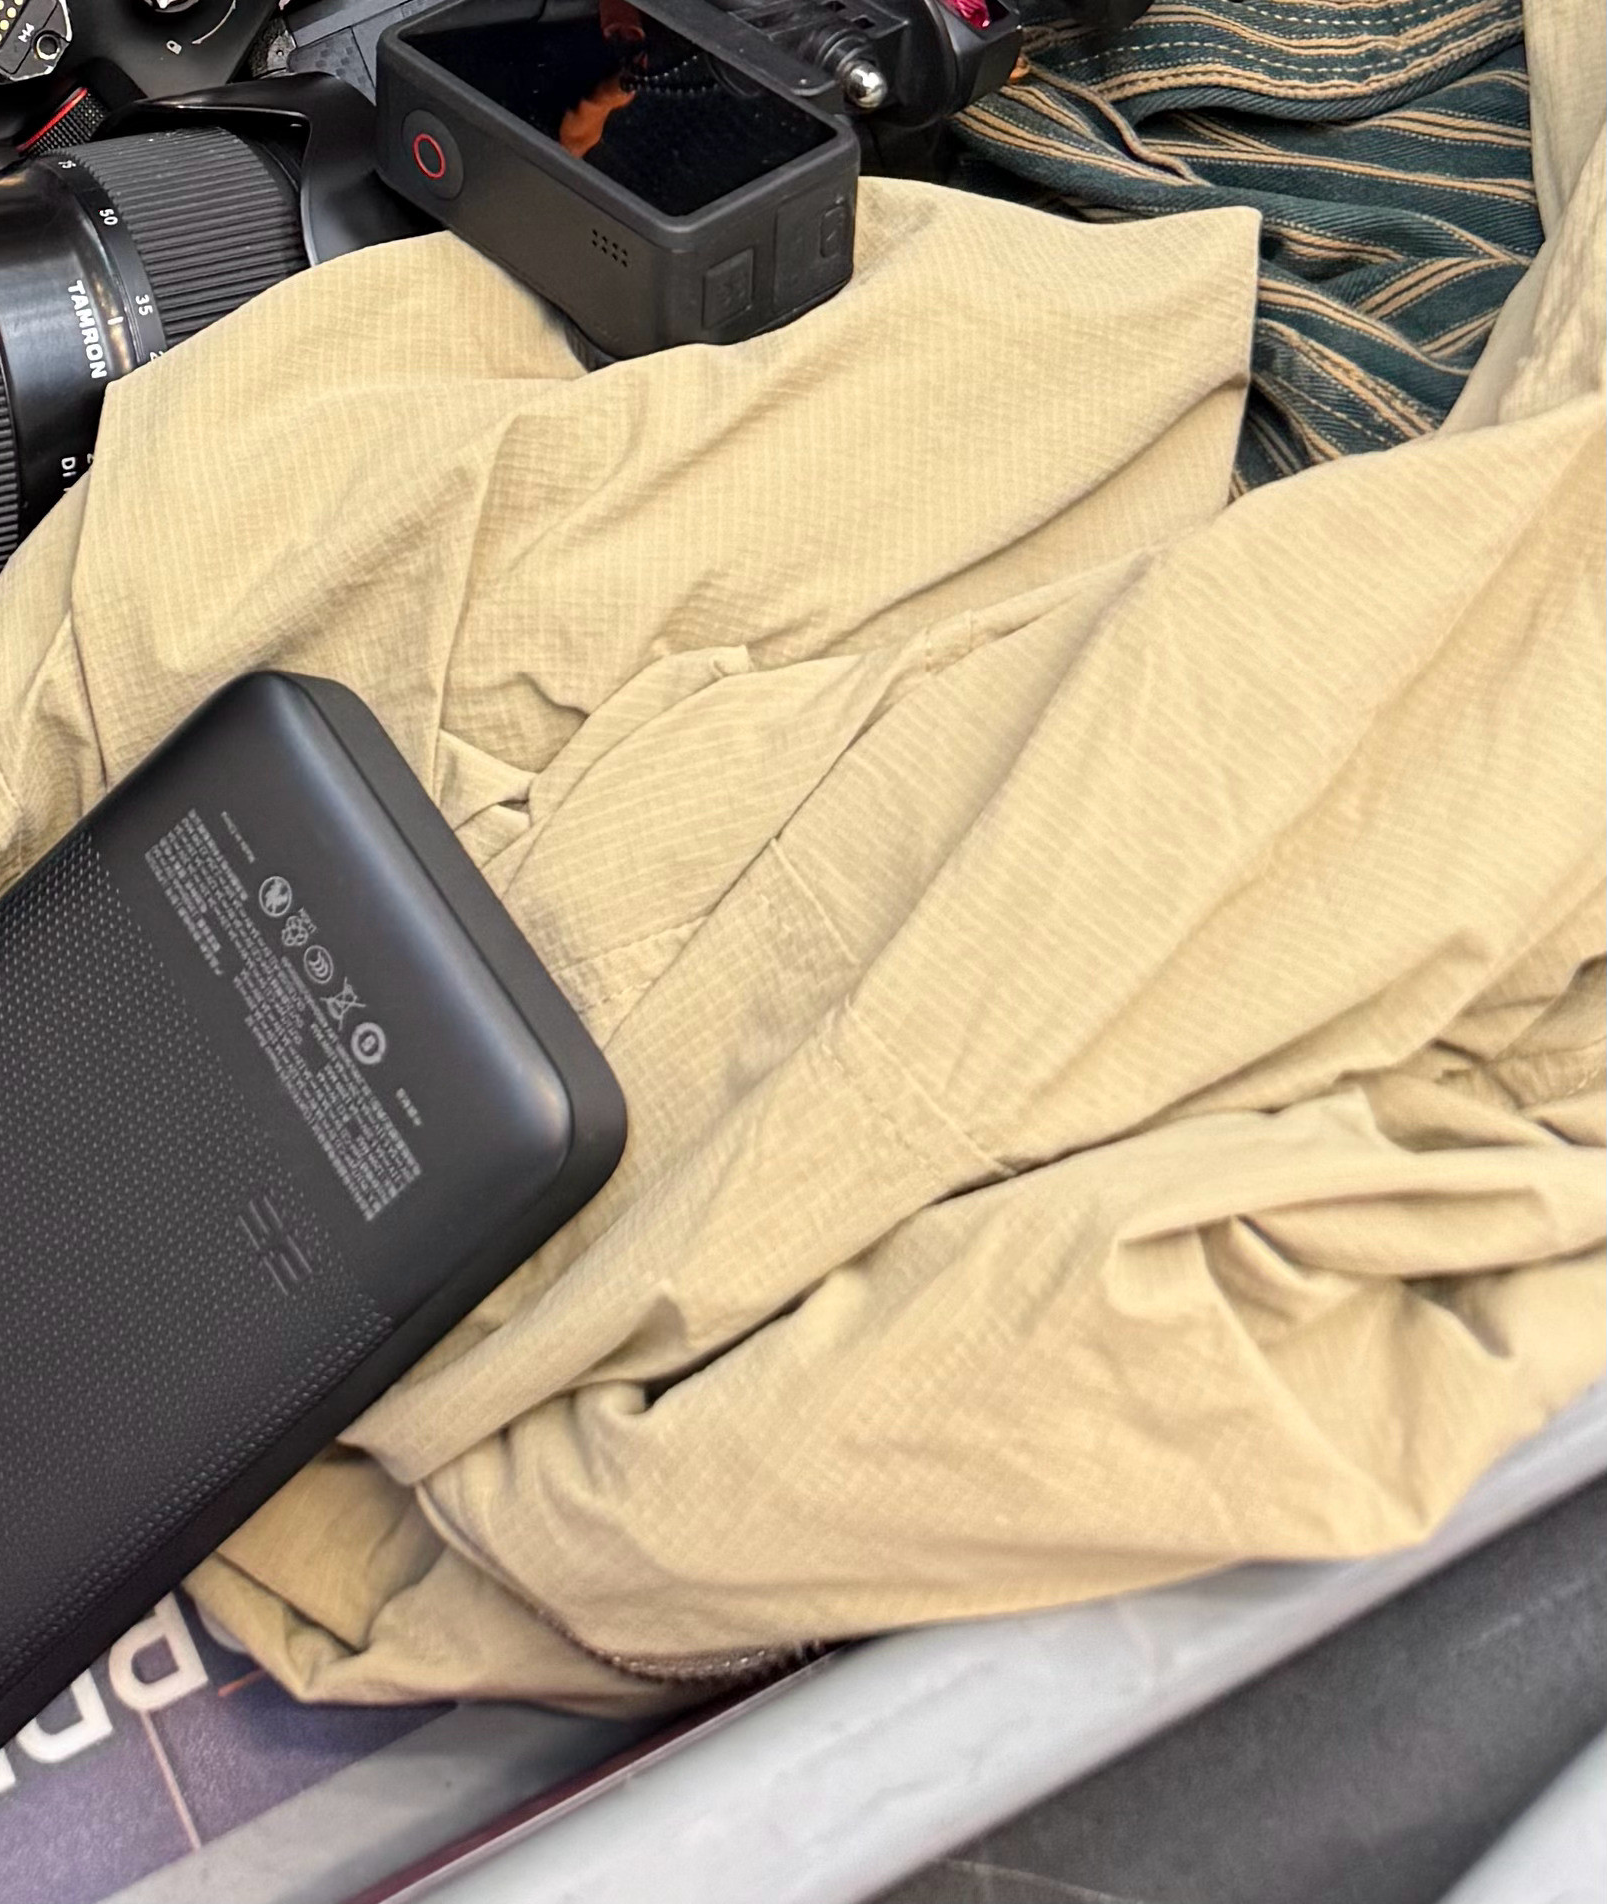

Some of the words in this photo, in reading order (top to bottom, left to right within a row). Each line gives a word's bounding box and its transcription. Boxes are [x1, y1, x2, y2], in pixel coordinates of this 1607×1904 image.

[99, 207, 119, 226] 50
[135, 294, 154, 317] 35
[67, 279, 108, 380] TAMRON
